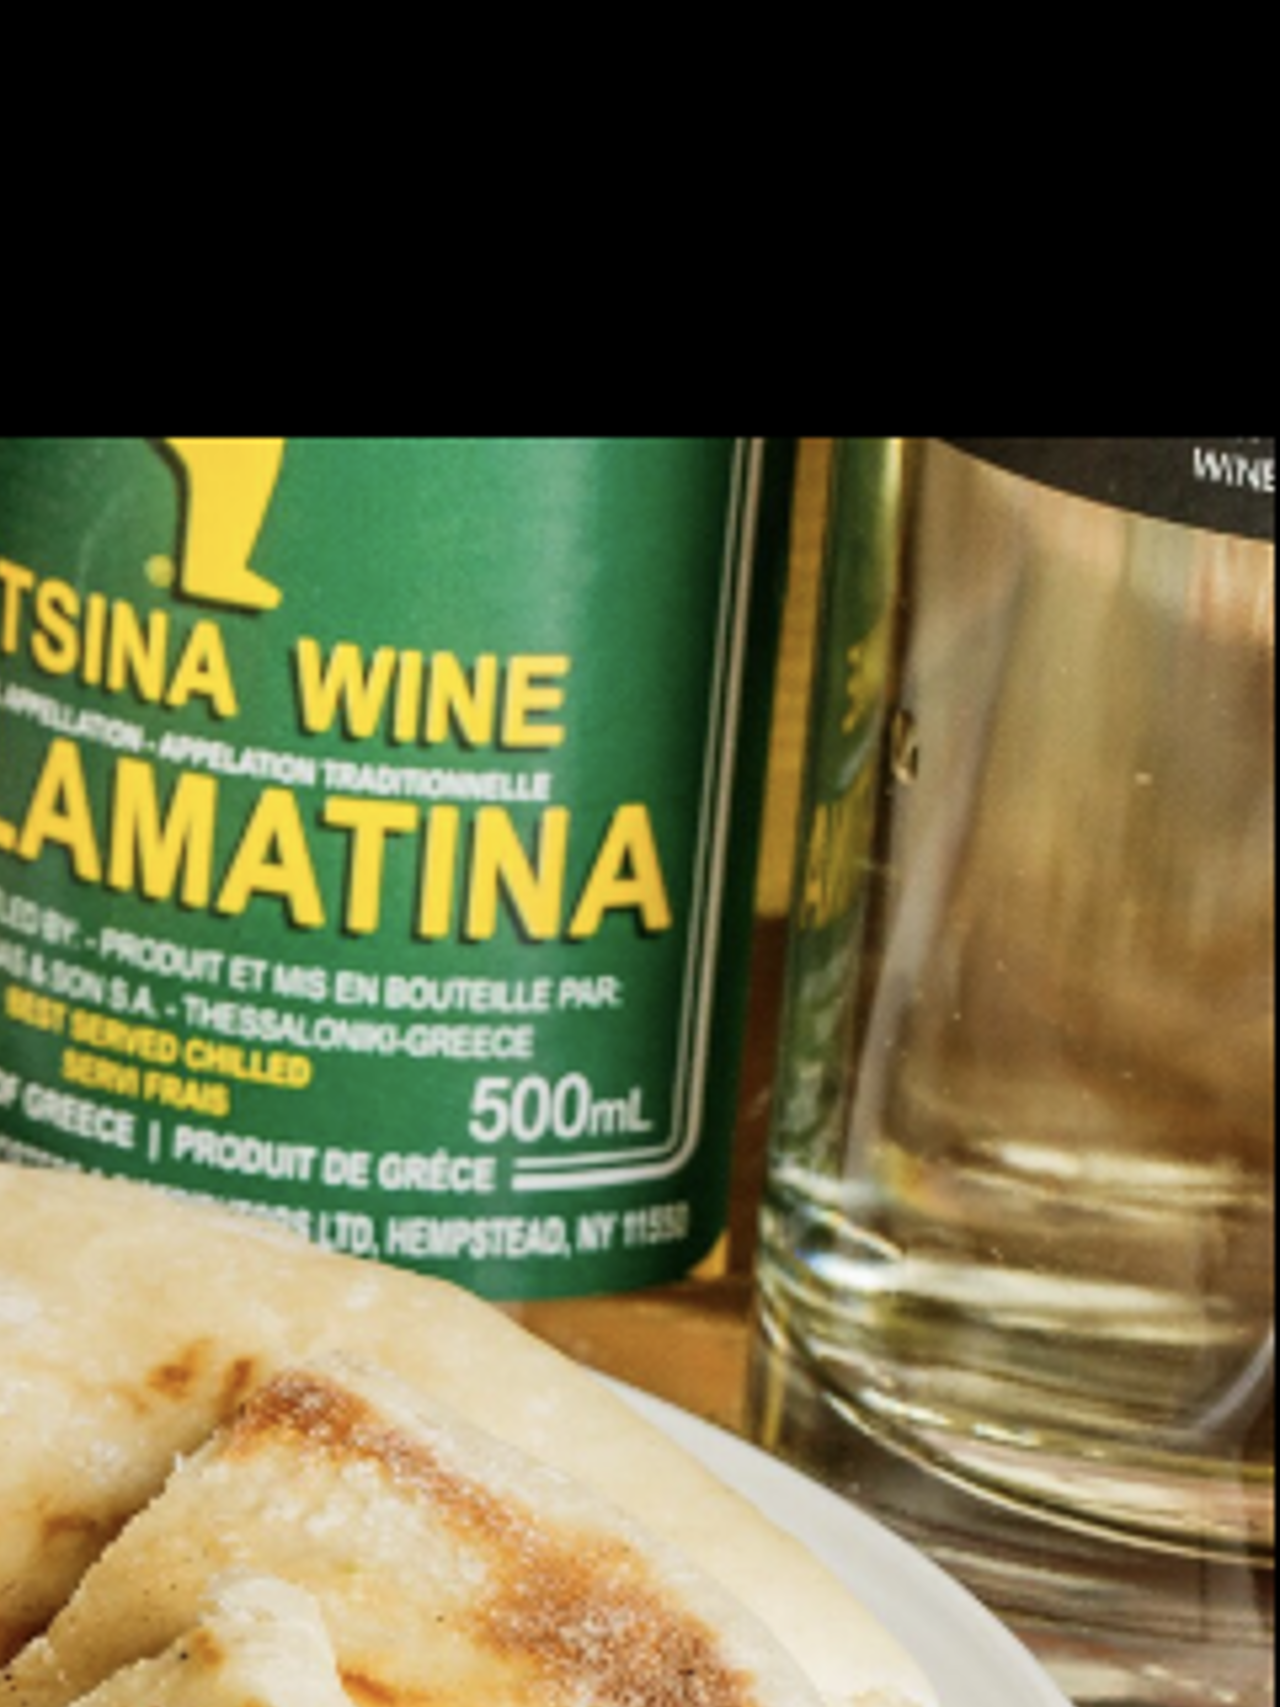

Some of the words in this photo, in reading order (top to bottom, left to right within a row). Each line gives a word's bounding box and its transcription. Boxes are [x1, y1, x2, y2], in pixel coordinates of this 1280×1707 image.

[1193, 446, 1275, 493] WINE
[297, 637, 571, 747] WINE
[100, 928, 224, 985] PRODUIT
[229, 954, 268, 988] ET
[272, 964, 327, 1003] MIS
[336, 971, 380, 1006] EN
[384, 975, 554, 1014] BOUTEILLE
[5, 985, 67, 1034] BEST
[69, 1008, 180, 1065] SERVED
[185, 1036, 312, 1088] CHILLED
[22, 1082, 136, 1149] GREECE
[174, 1122, 315, 1183] PRODUIT
[322, 1147, 369, 1189] DE
[469, 1073, 653, 1142] 500mL
[576, 1209, 620, 1252] NY
